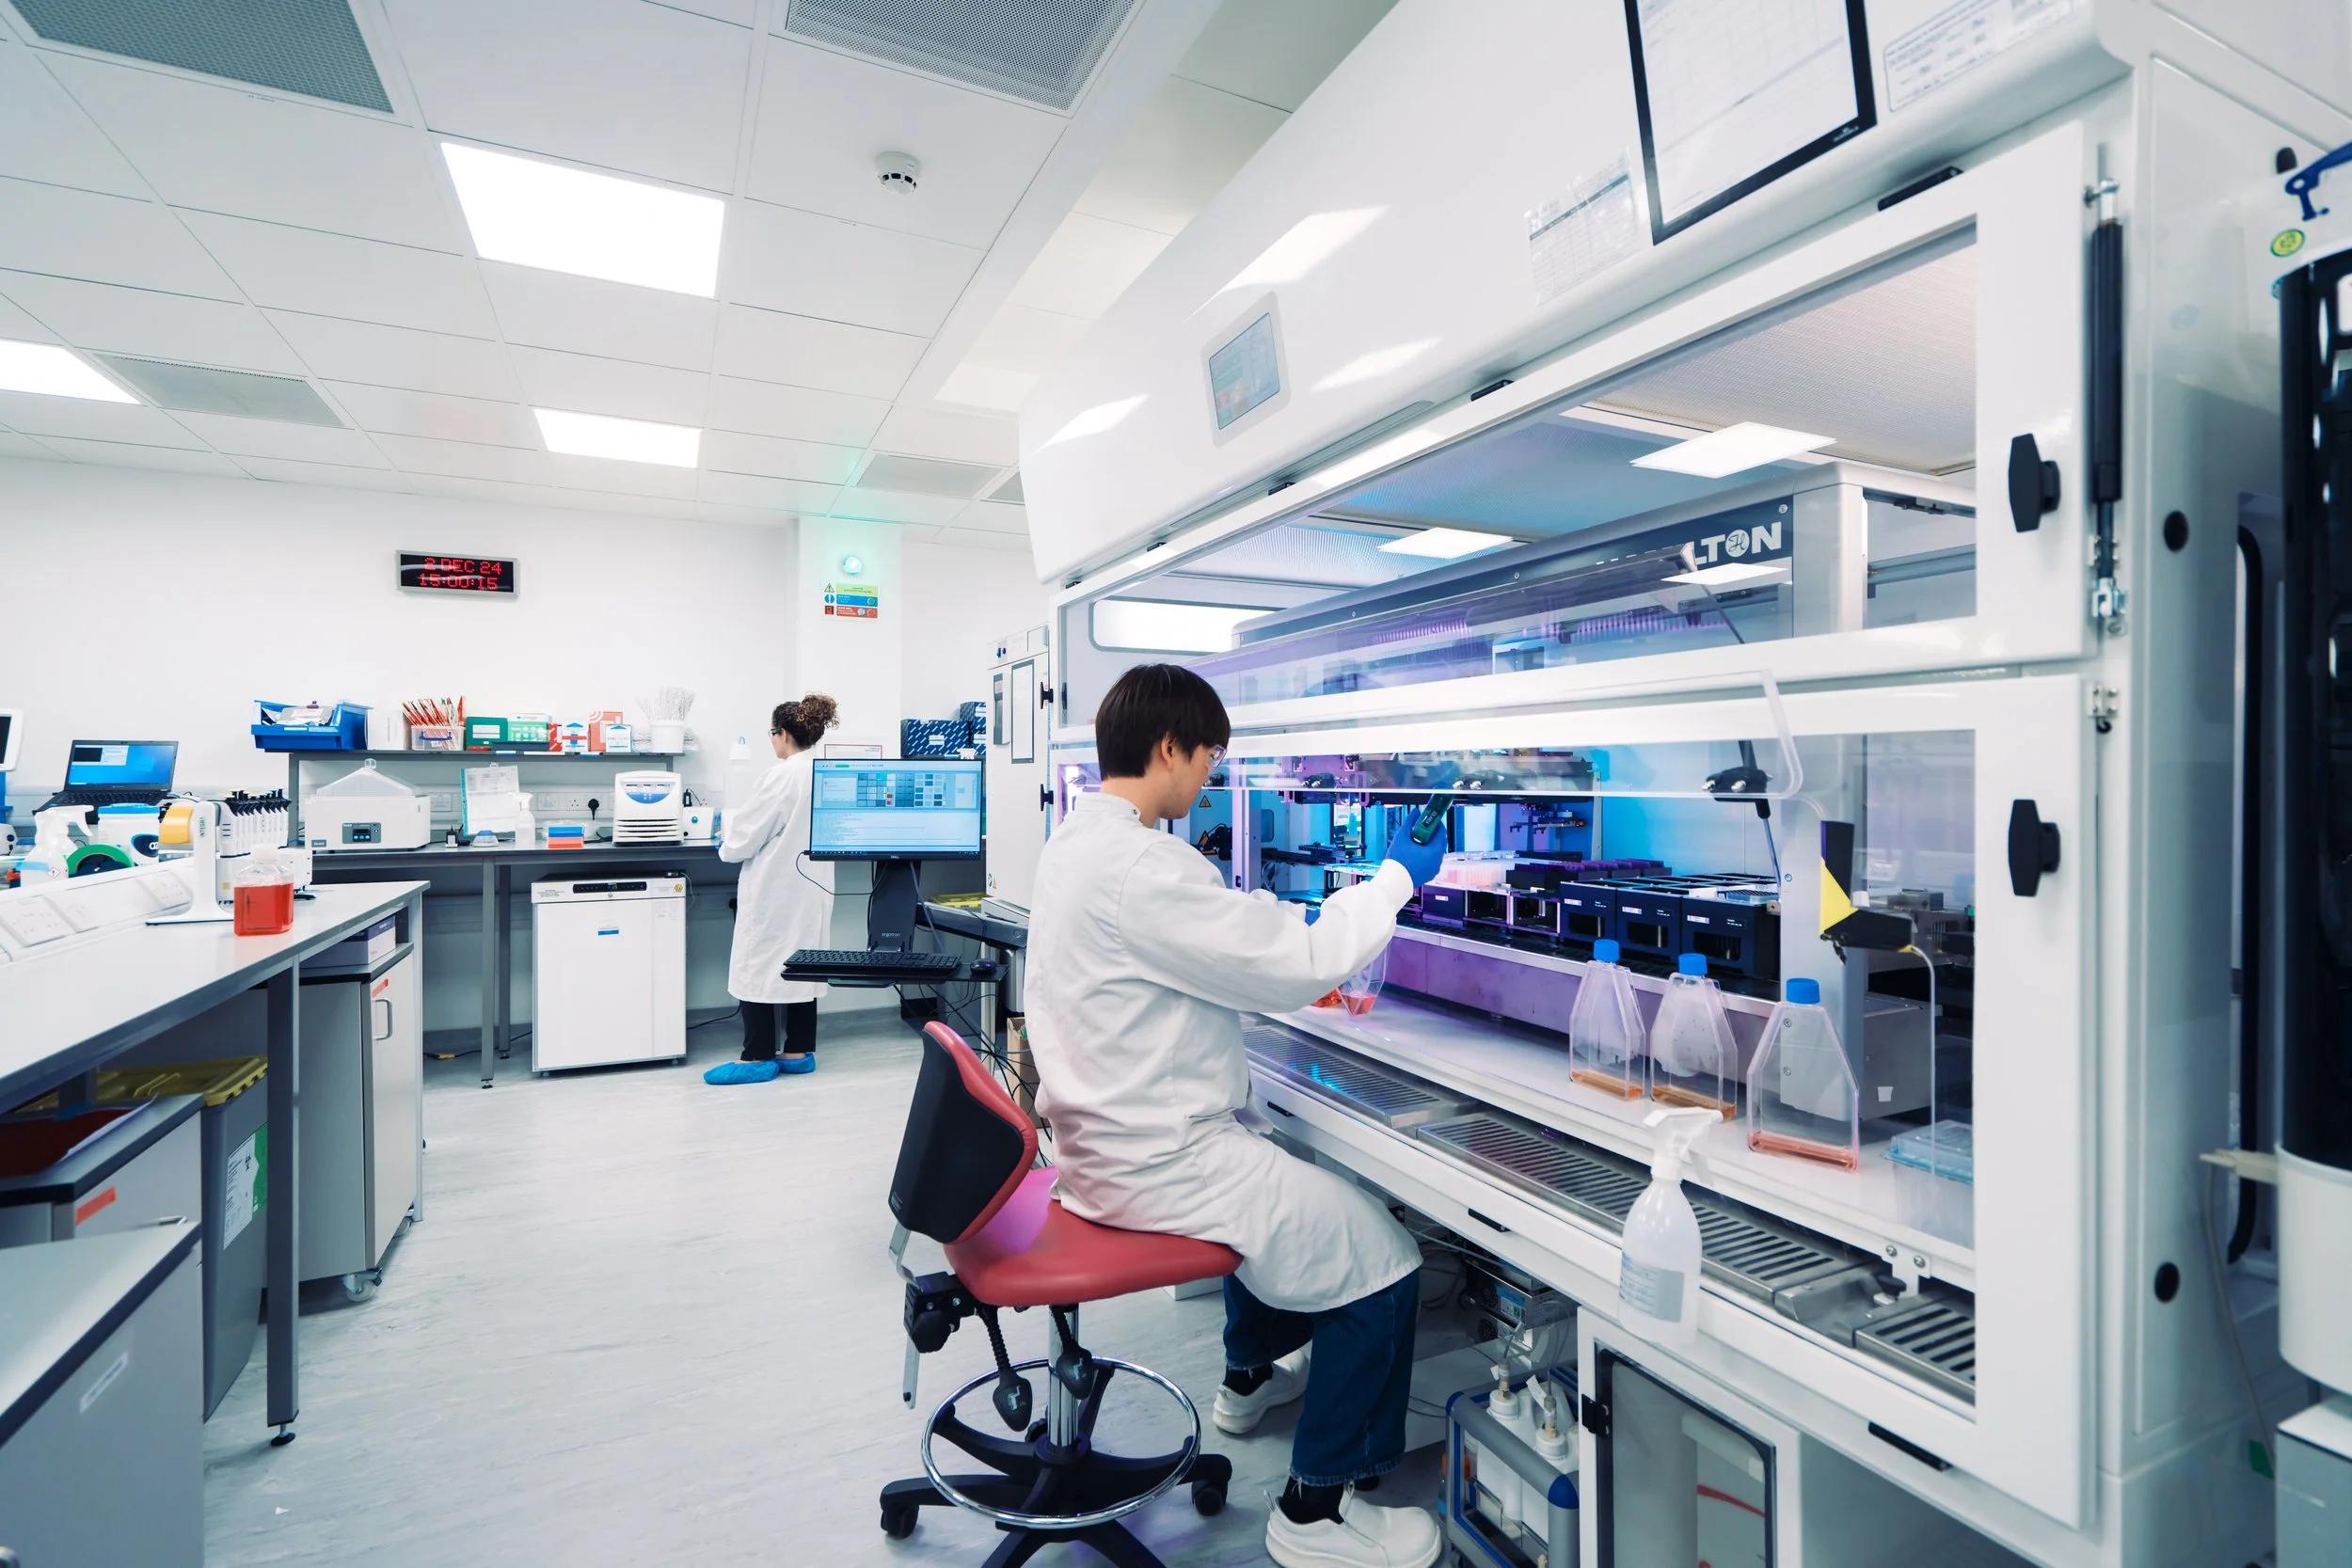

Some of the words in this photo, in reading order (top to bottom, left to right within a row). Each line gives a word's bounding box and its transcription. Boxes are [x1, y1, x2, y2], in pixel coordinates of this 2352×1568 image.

[424, 557, 436, 571] 2
[441, 558, 475, 573] DEC
[480, 561, 503, 575] 24
[419, 573, 498, 590] 15:00:15
